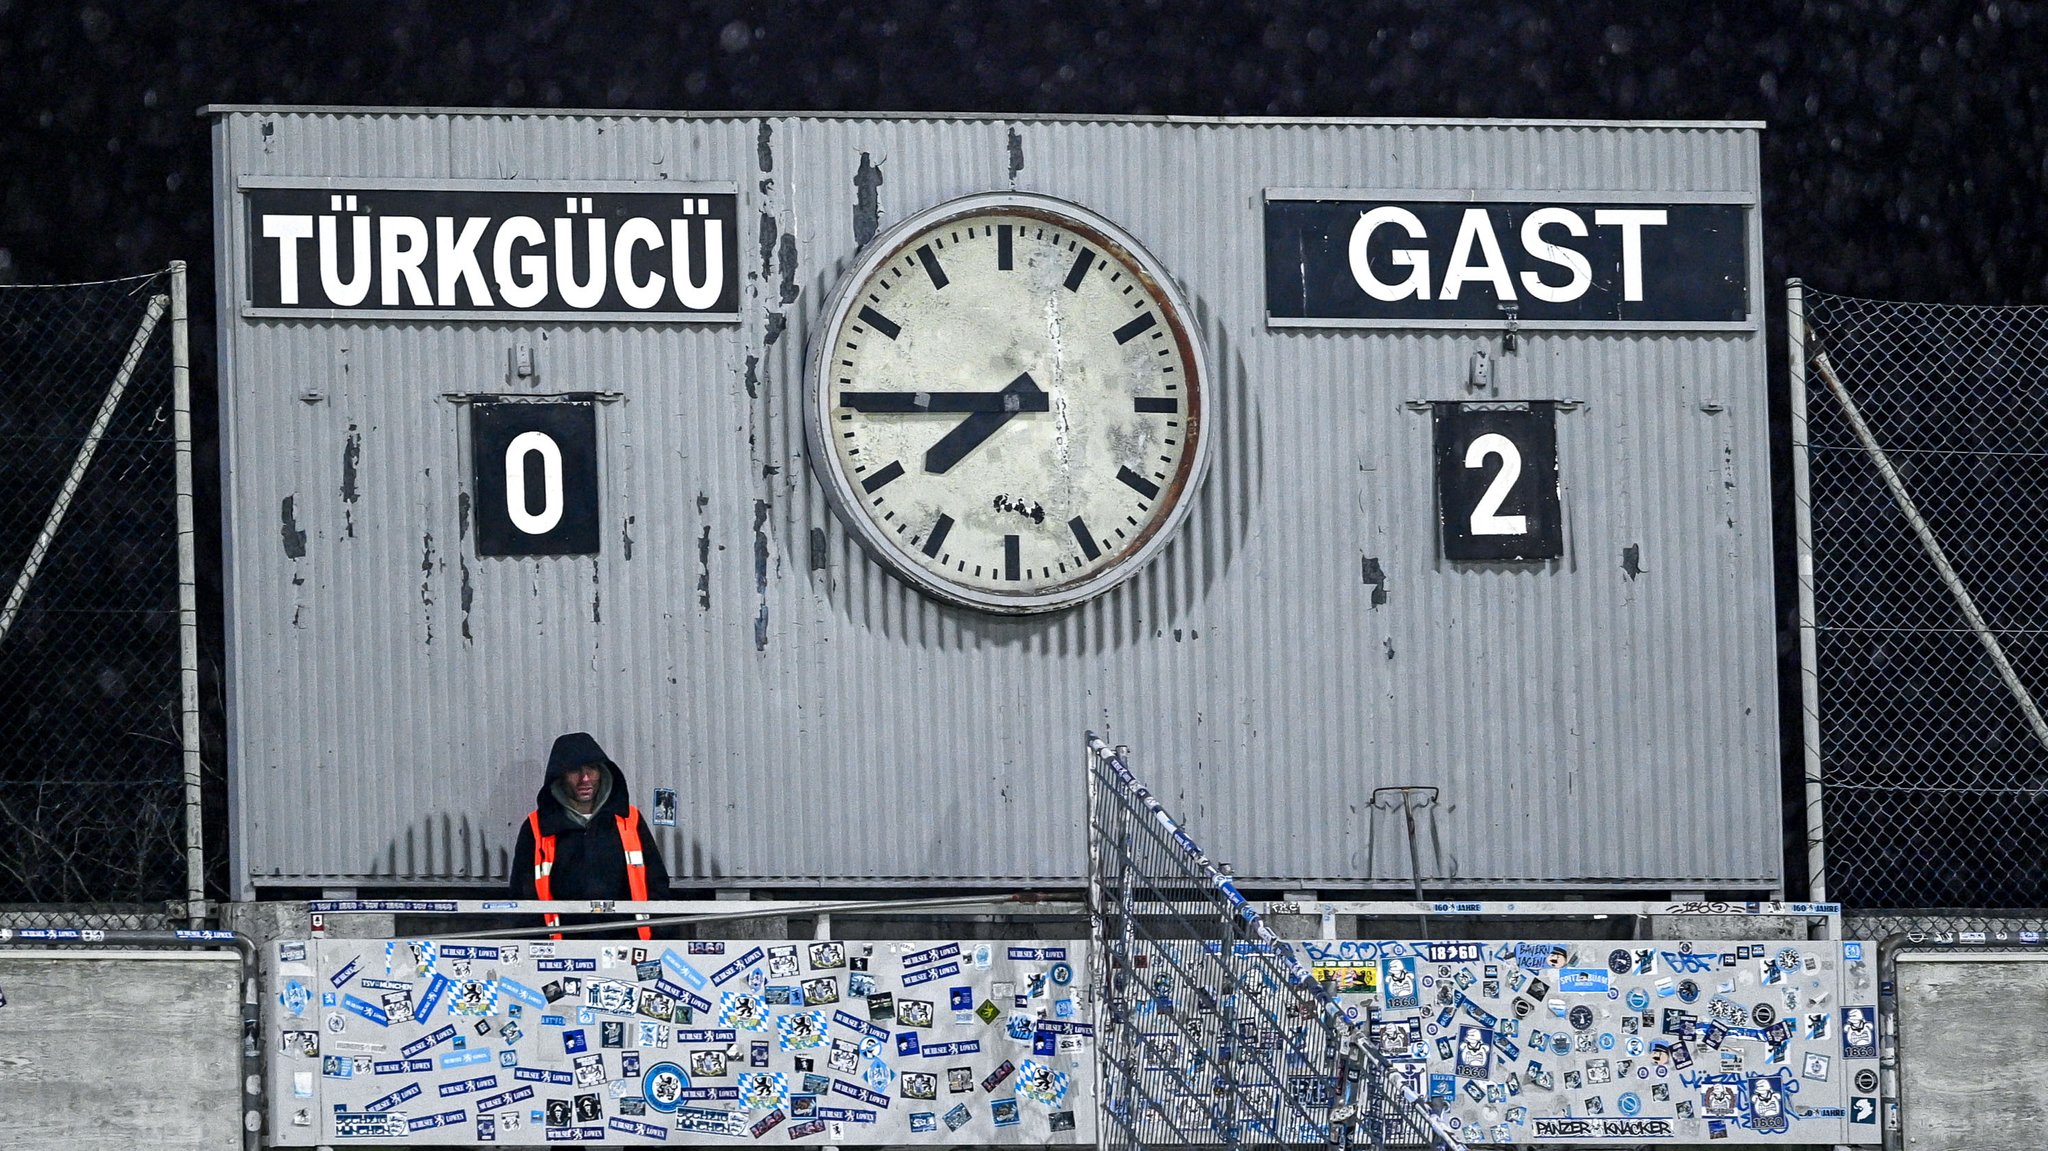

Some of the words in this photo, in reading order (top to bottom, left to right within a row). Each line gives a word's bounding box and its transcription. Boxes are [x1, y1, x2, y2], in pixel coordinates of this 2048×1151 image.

[262, 195, 723, 309] TÜRKGÜCÜ
[1348, 206, 1668, 303] GAST
[505, 431, 563, 535] 0
[1464, 433, 1527, 536] 2
[689, 942, 724, 954] 1860
[1389, 997, 1416, 1008] 1860
[1845, 1046, 1874, 1057] 1860
[1457, 1066, 1487, 1078] 1860
[1821, 1109, 1846, 1117] JAHRE
[1536, 1120, 1592, 1136] PANZER
[1604, 1119, 1671, 1135] KNACKER
[1754, 1117, 1782, 1128] 1860
